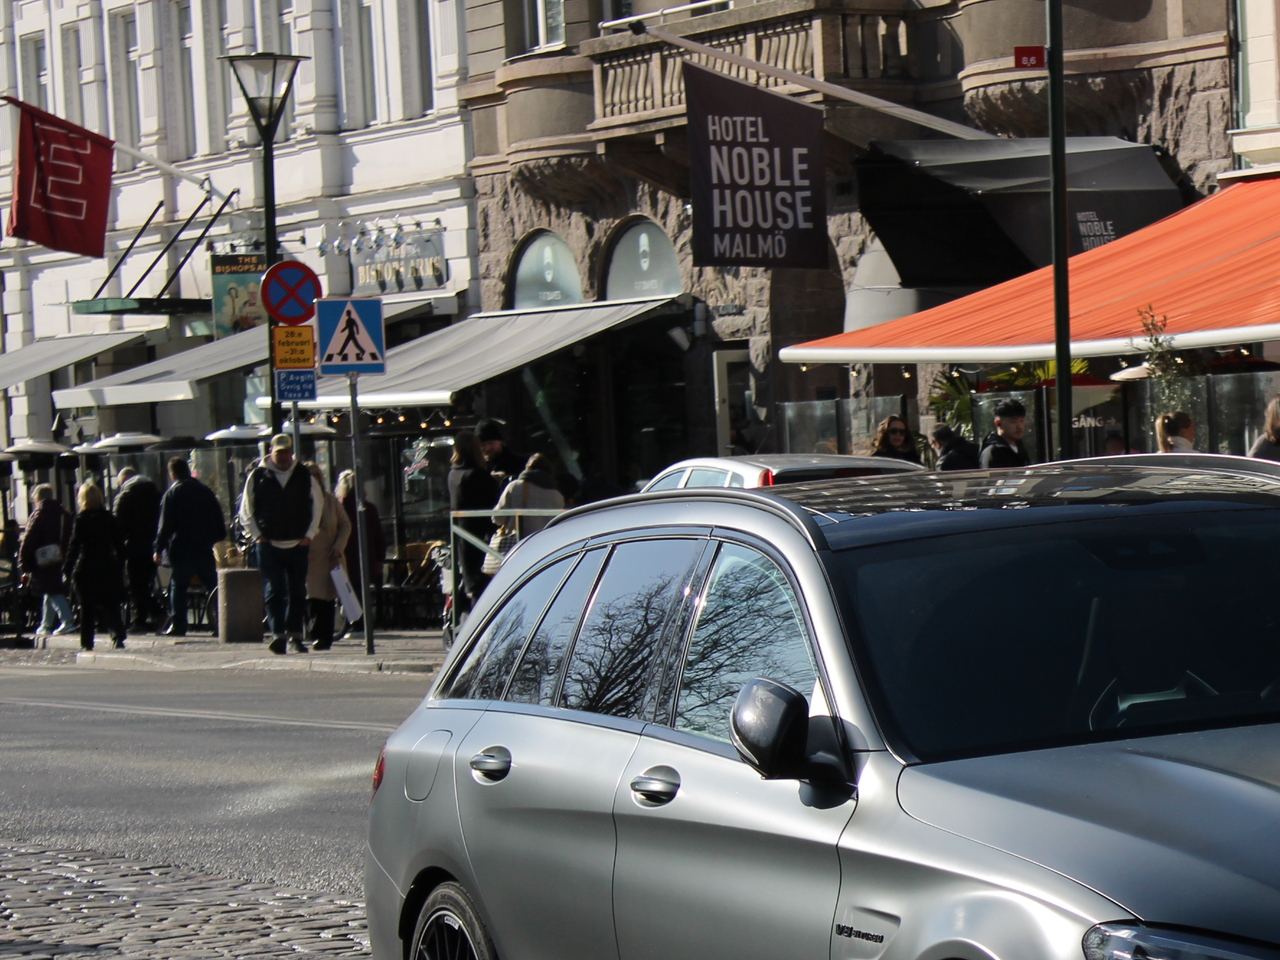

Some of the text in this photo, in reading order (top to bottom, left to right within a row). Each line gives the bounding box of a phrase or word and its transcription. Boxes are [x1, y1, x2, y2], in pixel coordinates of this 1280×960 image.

[707, 115, 770, 143] HOTEL
[709, 145, 811, 187] NOBLE
[712, 188, 814, 230] HOUSE
[1076, 211, 1099, 221] HOTEL
[1079, 221, 1116, 236] NOBLE
[713, 230, 787, 259] MALMÖ
[215, 264, 256, 273] BISHOPS
[278, 339, 311, 347] februari
[289, 374, 314, 382] Avgift
